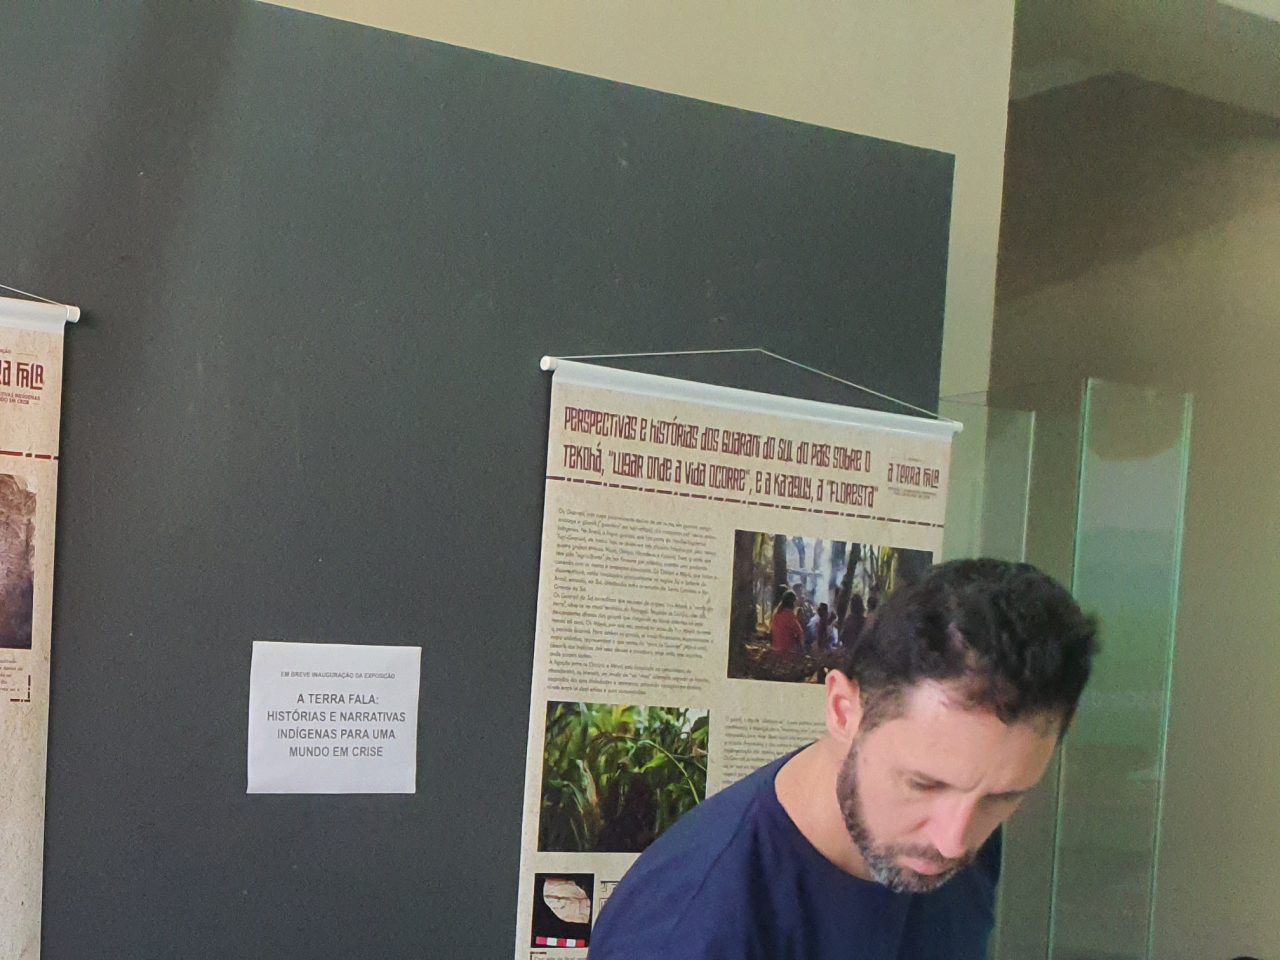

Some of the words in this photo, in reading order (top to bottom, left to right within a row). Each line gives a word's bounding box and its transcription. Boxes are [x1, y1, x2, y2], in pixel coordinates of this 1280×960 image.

[296, 693, 305, 704] A
[308, 693, 345, 704] TERRA
[348, 694, 378, 705] FALA:
[267, 709, 326, 722] HISTÓRIAS
[329, 711, 336, 722] E
[340, 711, 405, 722] NARRATIVAS
[277, 727, 337, 739] INDÍGENAS
[340, 729, 370, 739] PARA
[372, 729, 396, 739] UMA
[289, 746, 330, 757] MUNDO
[332, 746, 348, 757] EM
[352, 746, 383, 757] CRISE
